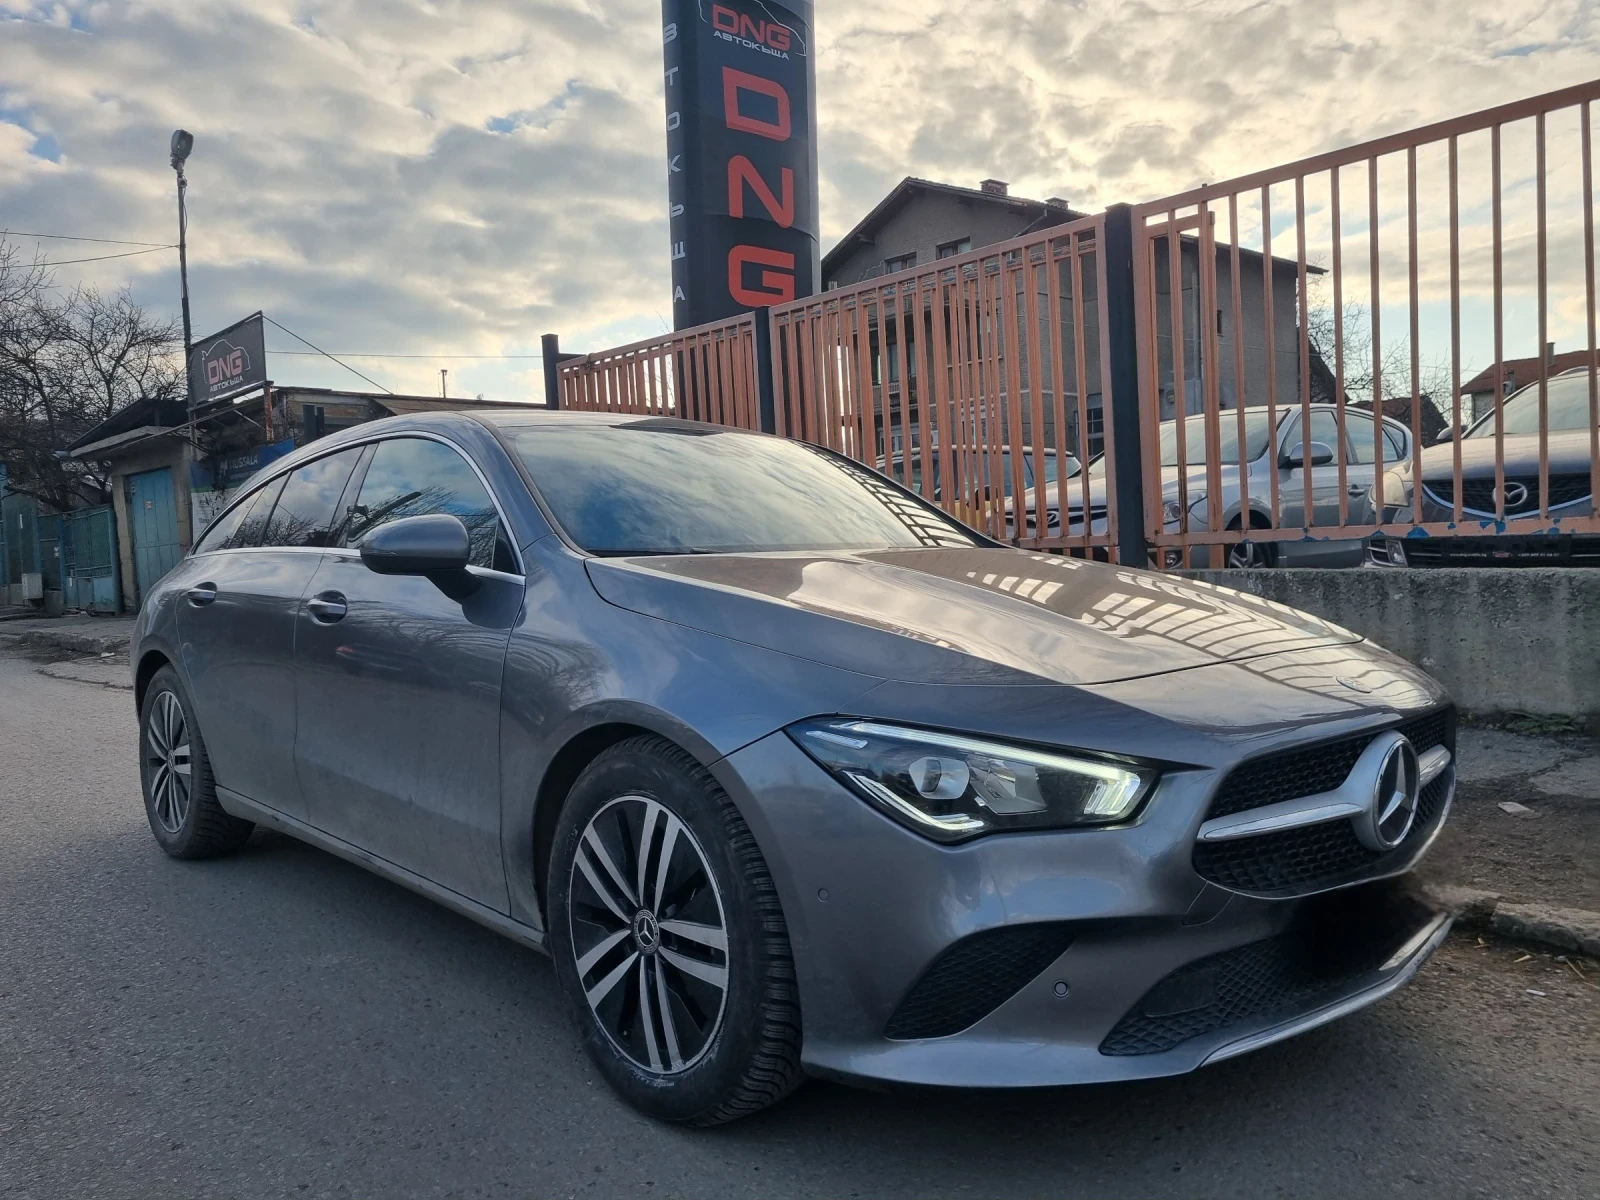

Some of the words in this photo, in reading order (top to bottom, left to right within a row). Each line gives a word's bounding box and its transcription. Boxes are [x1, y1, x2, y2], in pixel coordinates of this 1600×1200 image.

[712, 4, 791, 51] DNG
[713, 30, 790, 60] АВТОКЪЩА
[722, 66, 795, 308] DNG
[207, 349, 242, 384] DNG
